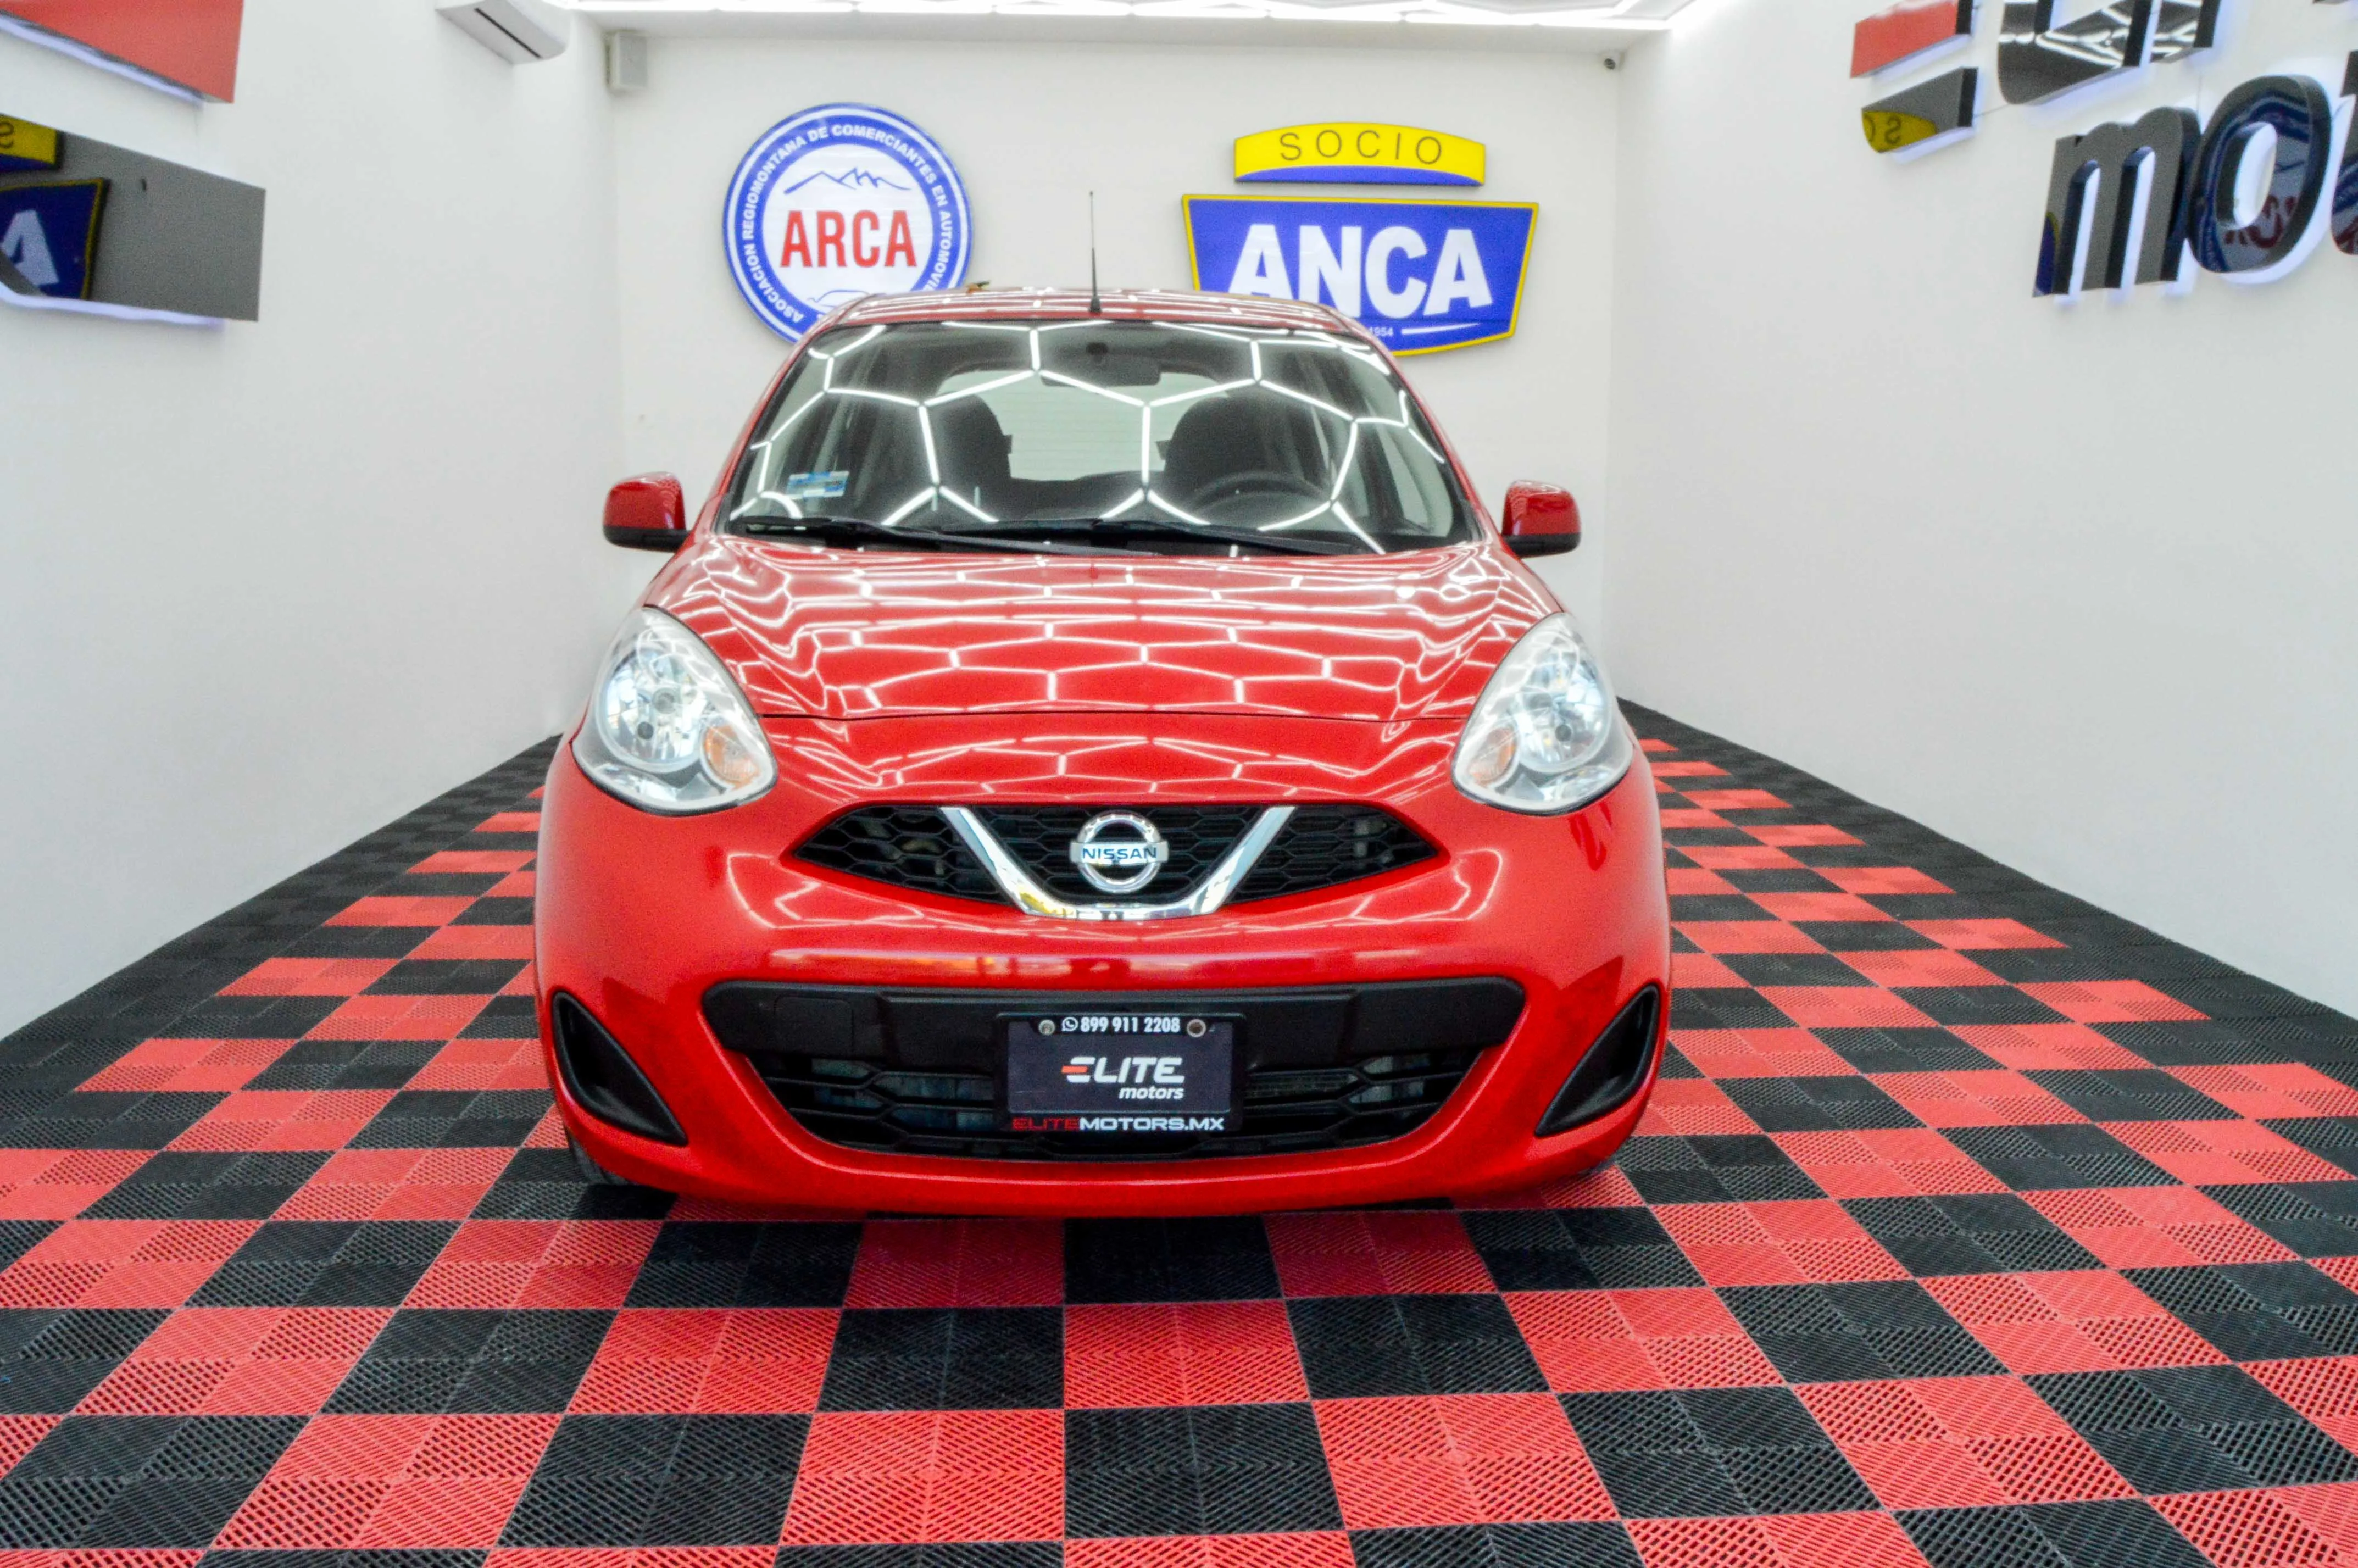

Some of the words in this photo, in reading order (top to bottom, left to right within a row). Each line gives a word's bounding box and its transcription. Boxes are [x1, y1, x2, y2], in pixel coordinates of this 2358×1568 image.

[807, 126, 829, 142] DE
[1279, 130, 1442, 165] SOCIO
[831, 124, 937, 184] COMERCIANTES
[742, 136, 808, 240] REGIOMONTANA
[932, 185, 948, 207] EN
[780, 210, 917, 268] ARCA
[744, 243, 804, 323] ASOCIACION
[1228, 224, 1493, 319] ANCA
[1082, 848, 1156, 859] NISSAN
[1081, 1017, 1108, 1032] 899
[1112, 1017, 1138, 1032] 911
[1144, 1017, 1181, 1032] 2208
[1061, 1057, 1185, 1083] ELITE
[1119, 1087, 1184, 1099] motors
